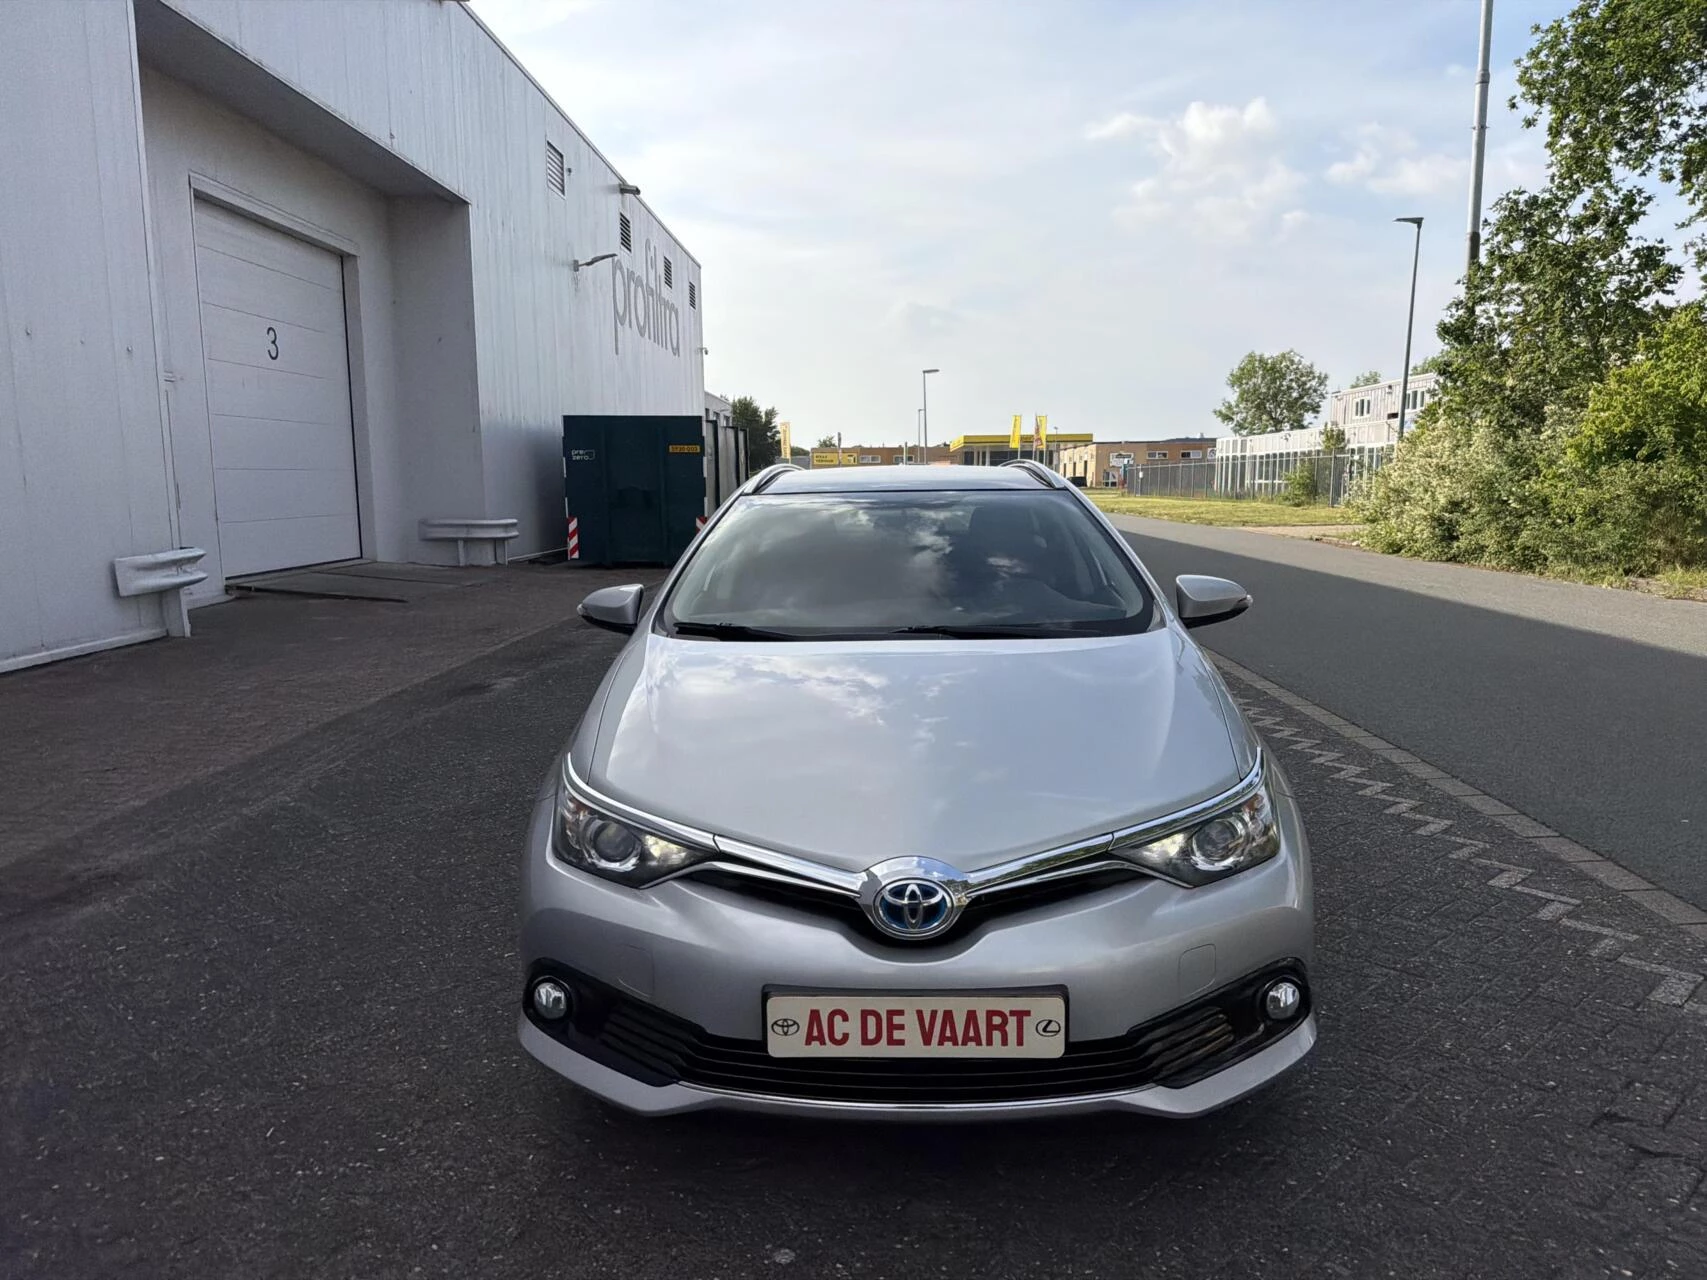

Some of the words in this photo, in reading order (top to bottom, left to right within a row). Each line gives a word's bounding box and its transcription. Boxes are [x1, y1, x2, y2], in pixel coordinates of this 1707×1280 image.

[611, 238, 680, 357] profiltra
[267, 326, 279, 360] 3
[804, 1008, 849, 1047] AC
[860, 1008, 905, 1047] DE
[915, 1008, 1032, 1047] VAART
